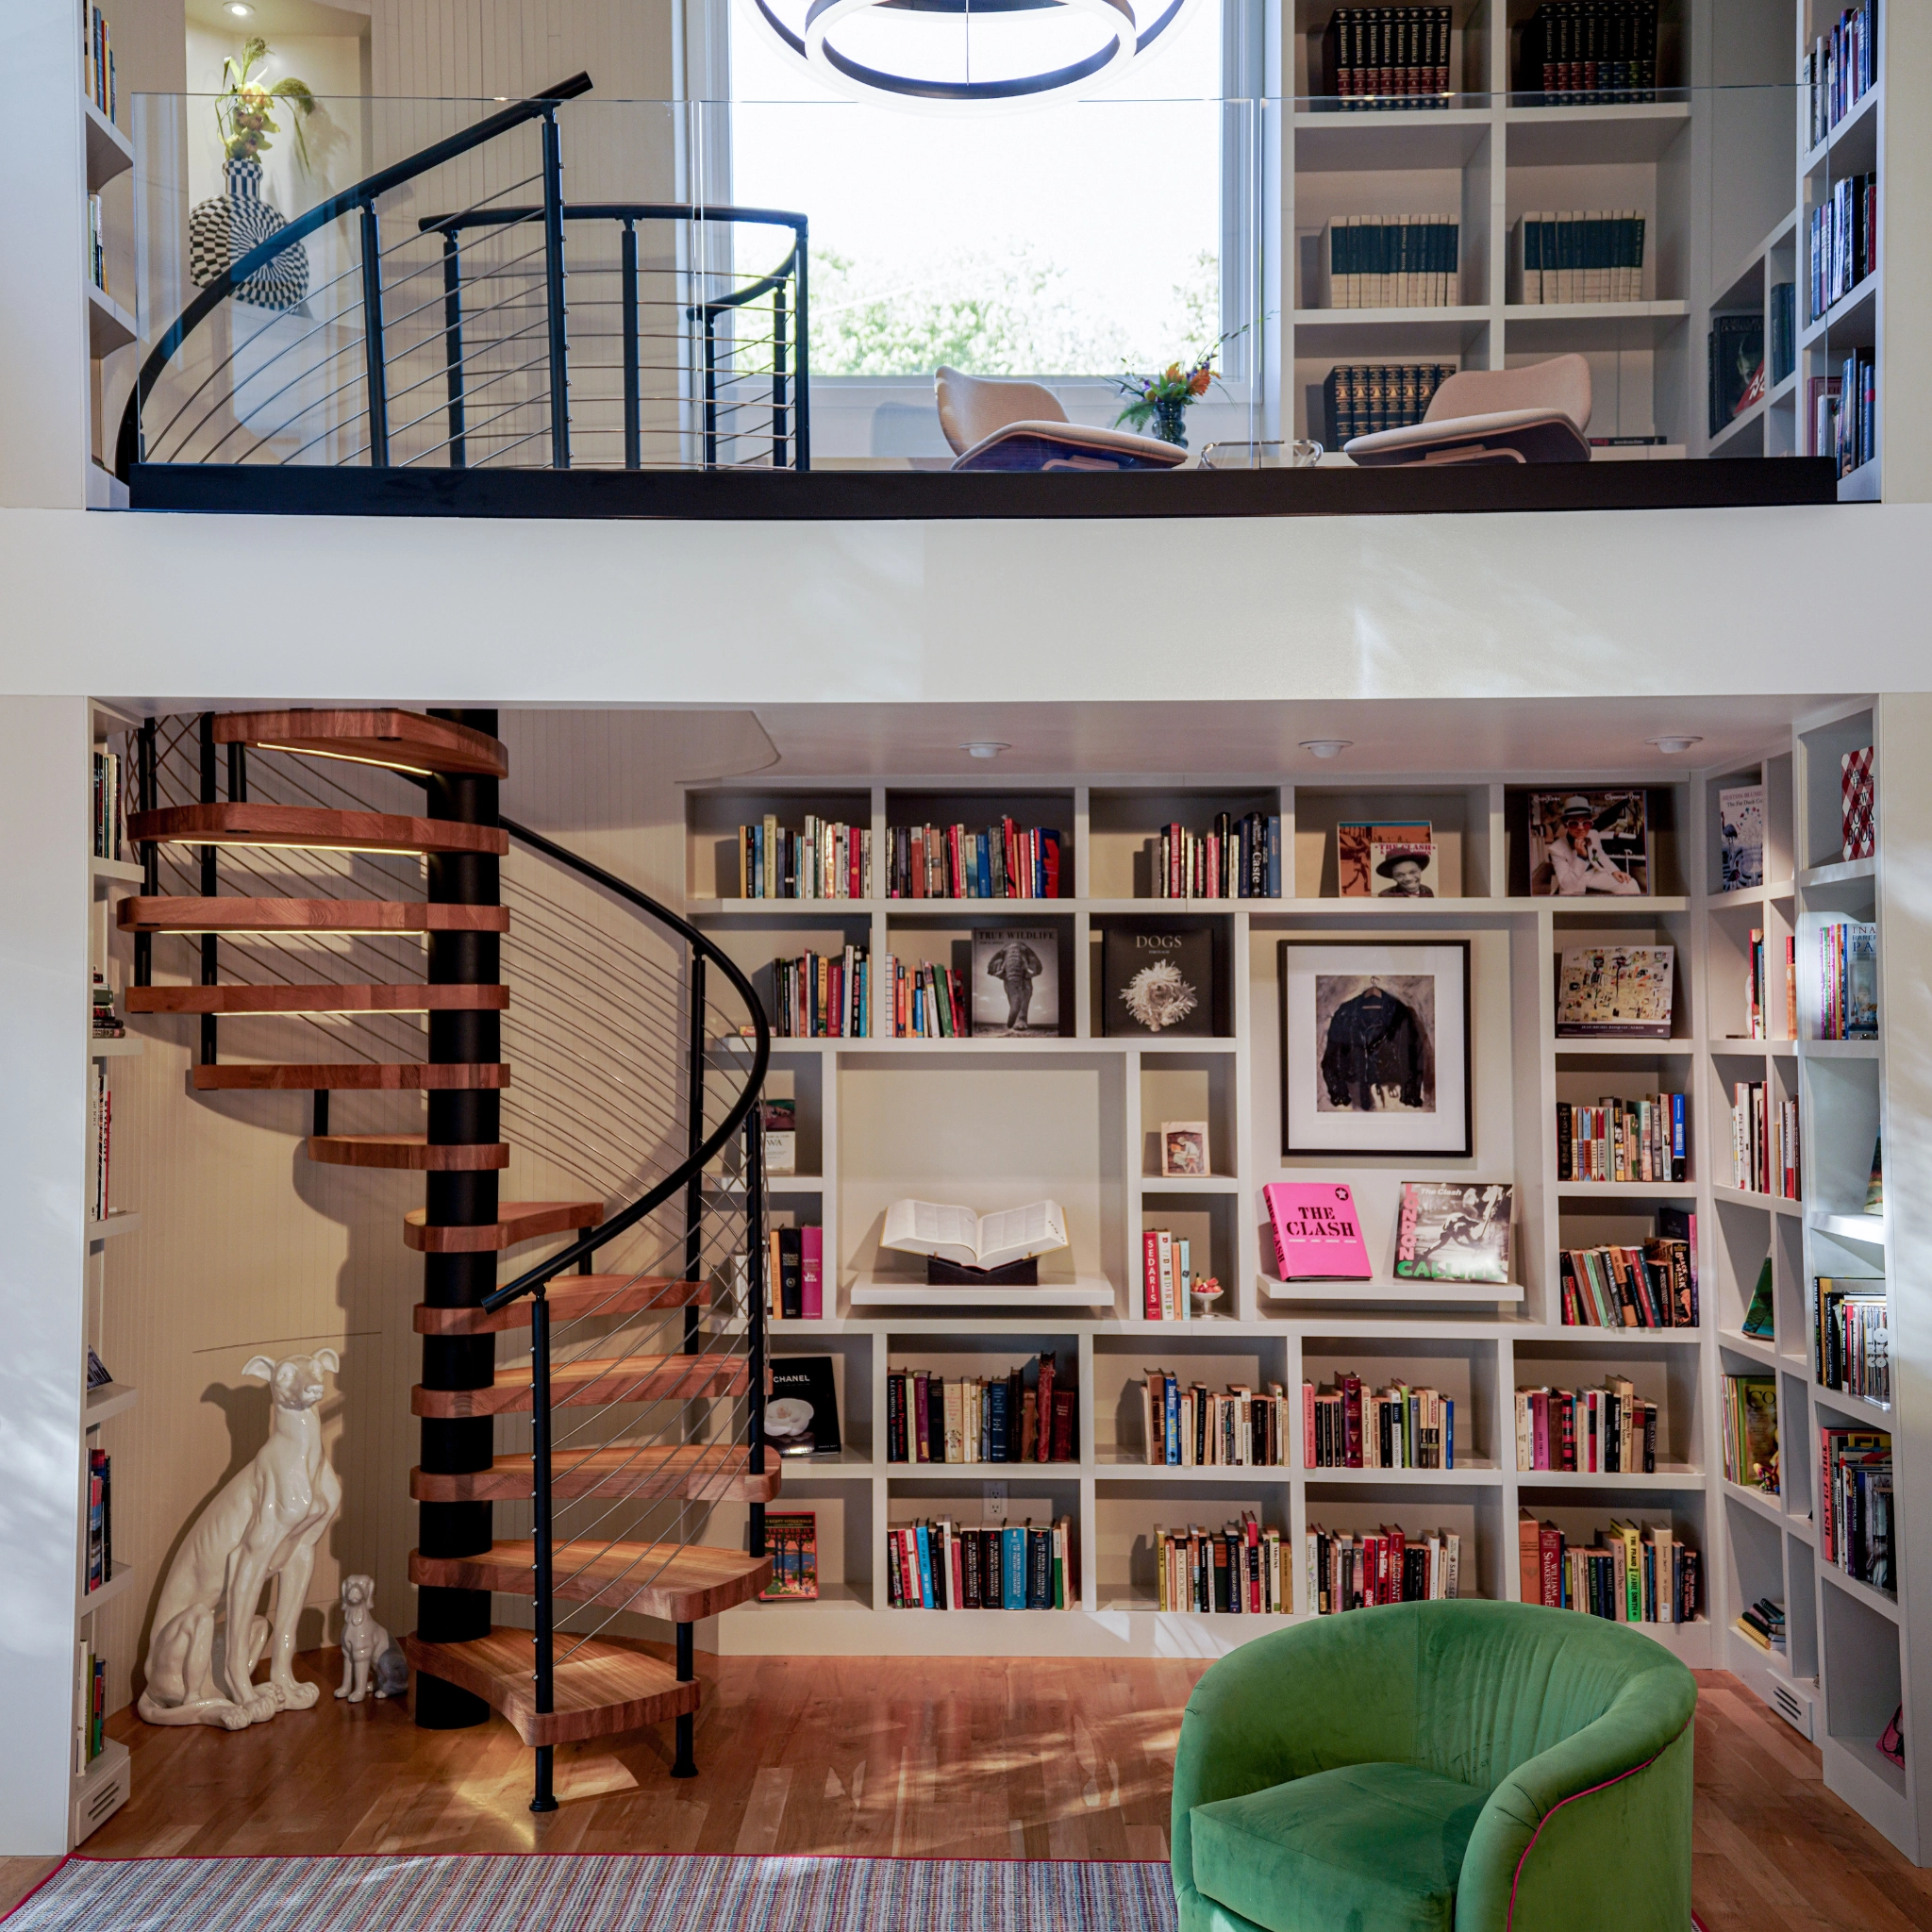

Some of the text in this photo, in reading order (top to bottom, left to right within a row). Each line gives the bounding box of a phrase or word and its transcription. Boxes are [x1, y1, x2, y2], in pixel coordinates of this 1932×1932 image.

[1397, 25, 1406, 63] Britannica
[1425, 24, 1434, 62] Britannica
[1440, 24, 1448, 62] Britannica
[1846, 804, 1874, 826] COOK
[1848, 824, 1874, 846] BOOK
[1252, 851, 1262, 883] Caste
[979, 931, 1055, 940] TRUE WILDLIFE
[1136, 935, 1182, 949] DOGS
[853, 997, 859, 1007] 66
[1298, 1207, 1336, 1220] THE
[1398, 1183, 1420, 1261] LONDON
[1265, 1195, 1286, 1263] THE CLASH
[1287, 1222, 1356, 1237] CLASH
[1146, 1239, 1158, 1304] SEDARIS
[1396, 1260, 1504, 1281] CALLING
[1675, 1252, 1689, 1274] BLACK
[1675, 1263, 1687, 1289] MASK
[1163, 1270, 1173, 1311] SEDARIS
[773, 1374, 811, 1383] CHANEL
[1167, 1385, 1176, 1410] Dave Barry
[1746, 1390, 1776, 1409] CO
[1178, 1567, 1187, 1598] KEROUAC
[1365, 1550, 1374, 1607] JAMES PATTERSON GONE
[1391, 1551, 1402, 1601] ALLEGIANT
[1543, 1551, 1555, 1607] SHAKESPEARE
[1617, 1575, 1625, 1590] Plays
